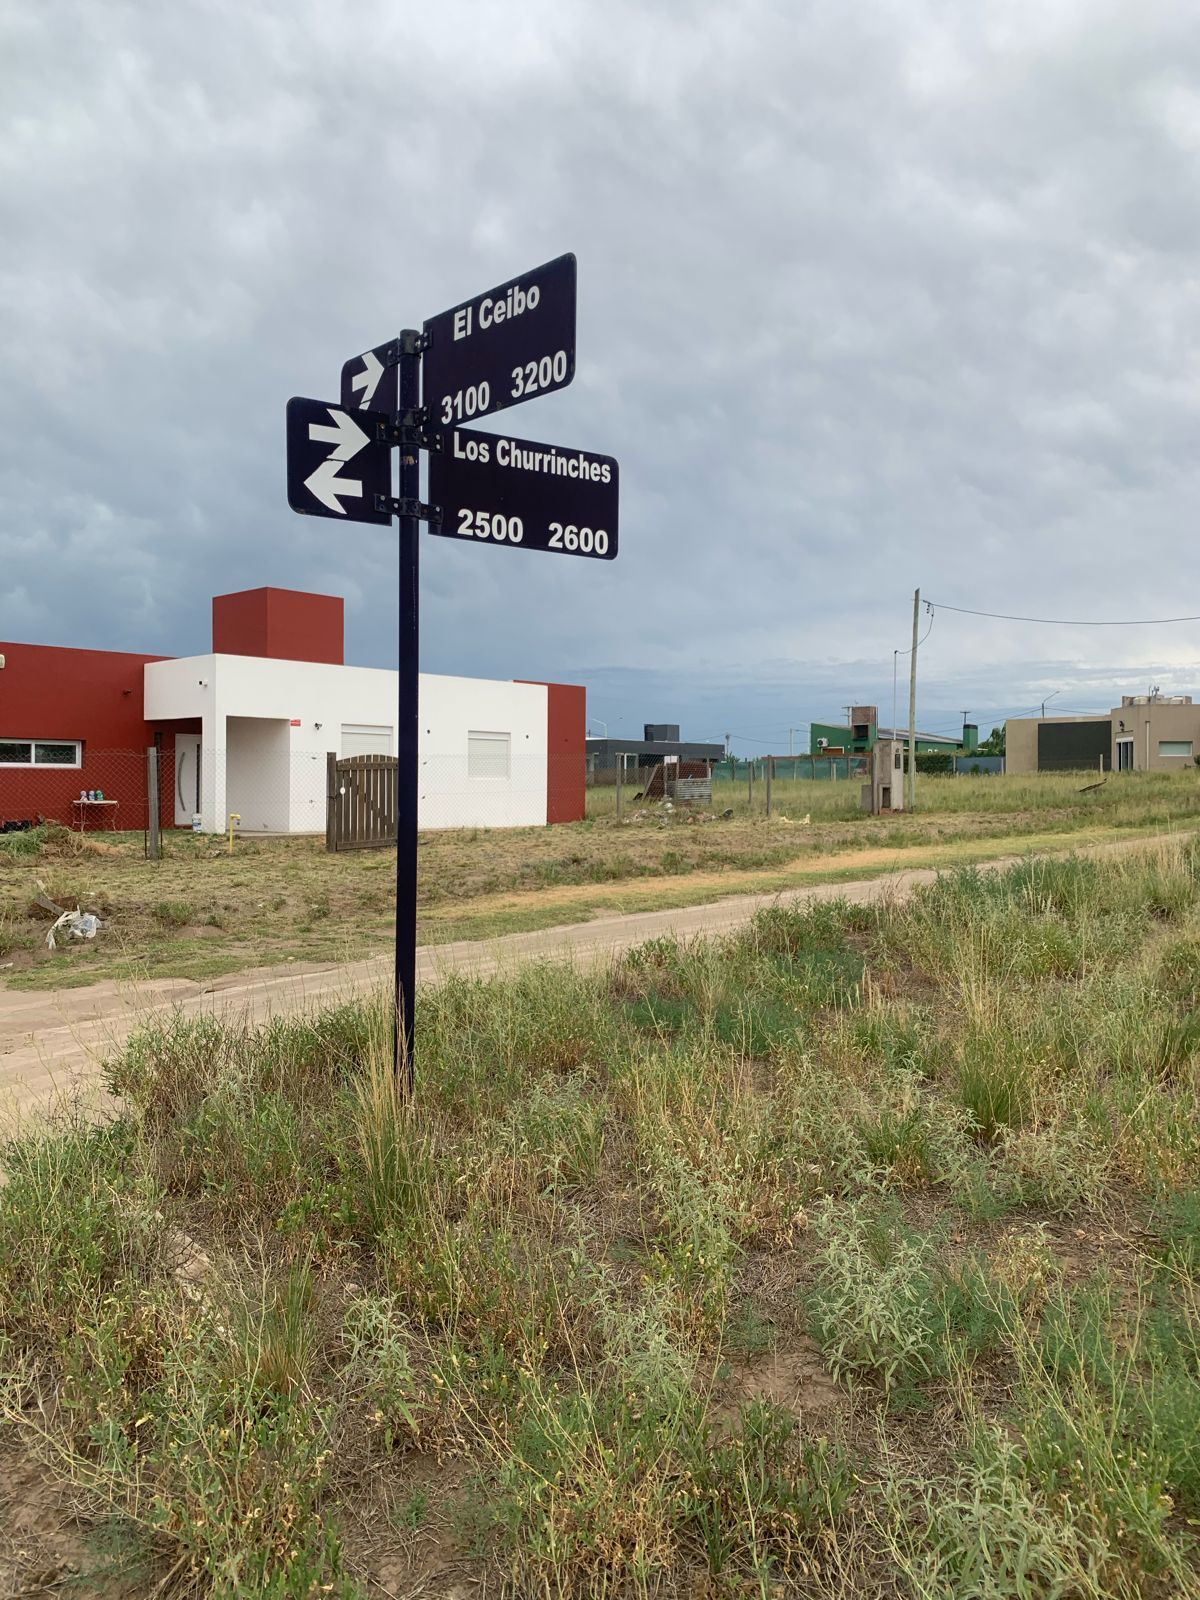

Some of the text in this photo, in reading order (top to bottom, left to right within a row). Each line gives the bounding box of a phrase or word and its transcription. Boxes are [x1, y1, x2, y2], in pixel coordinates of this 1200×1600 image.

[453, 285, 540, 341] El Ceibo
[441, 350, 567, 425] 3100 3200
[453, 431, 612, 484] Los Churrinches
[457, 508, 609, 555] 2500 2600
